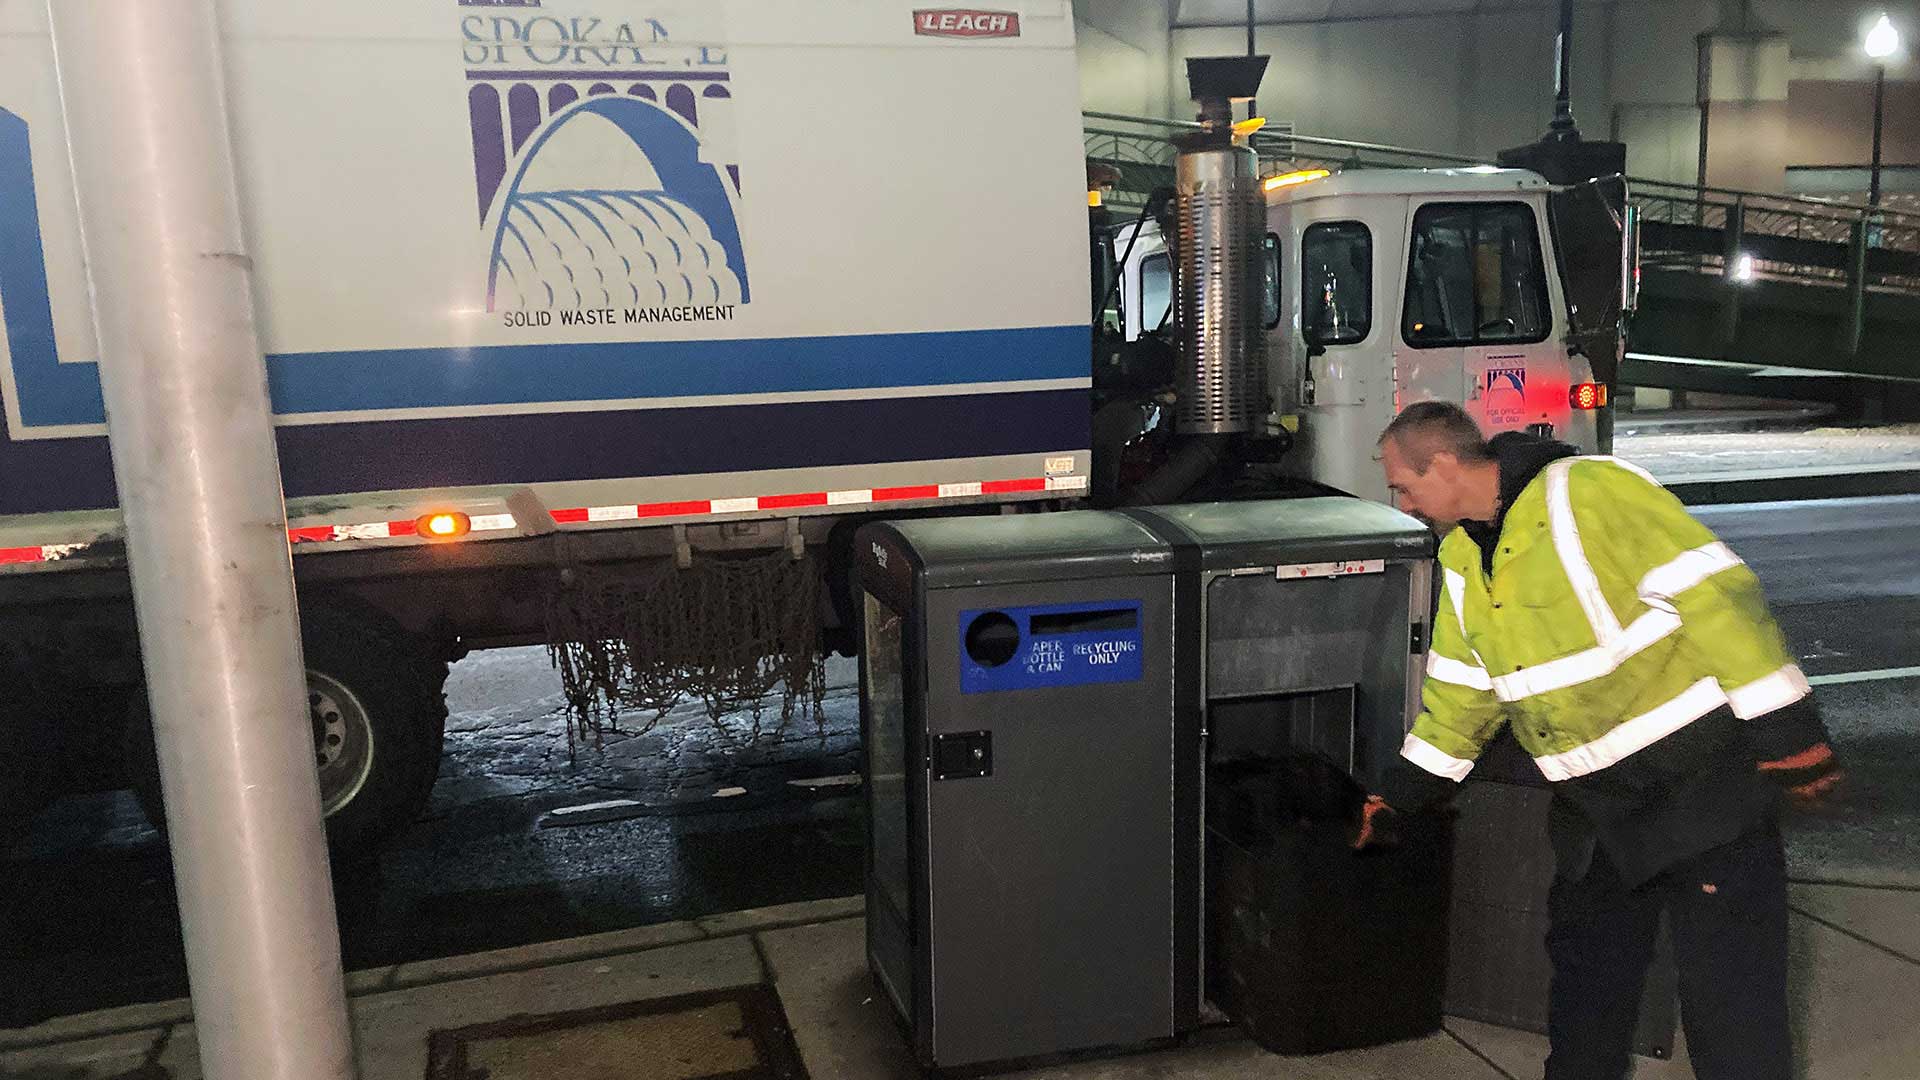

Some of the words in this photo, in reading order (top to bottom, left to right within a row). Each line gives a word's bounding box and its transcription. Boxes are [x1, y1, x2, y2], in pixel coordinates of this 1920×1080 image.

[922, 13, 1008, 31] LEACH
[503, 310, 552, 328] SOLID
[559, 308, 617, 326] WASTE
[624, 305, 735, 323] MANAGEMENT
[1032, 640, 1063, 652] APER
[1073, 641, 1136, 655] RECYCLING
[1088, 652, 1120, 665] ONLY
[1039, 663, 1062, 672] CAN
